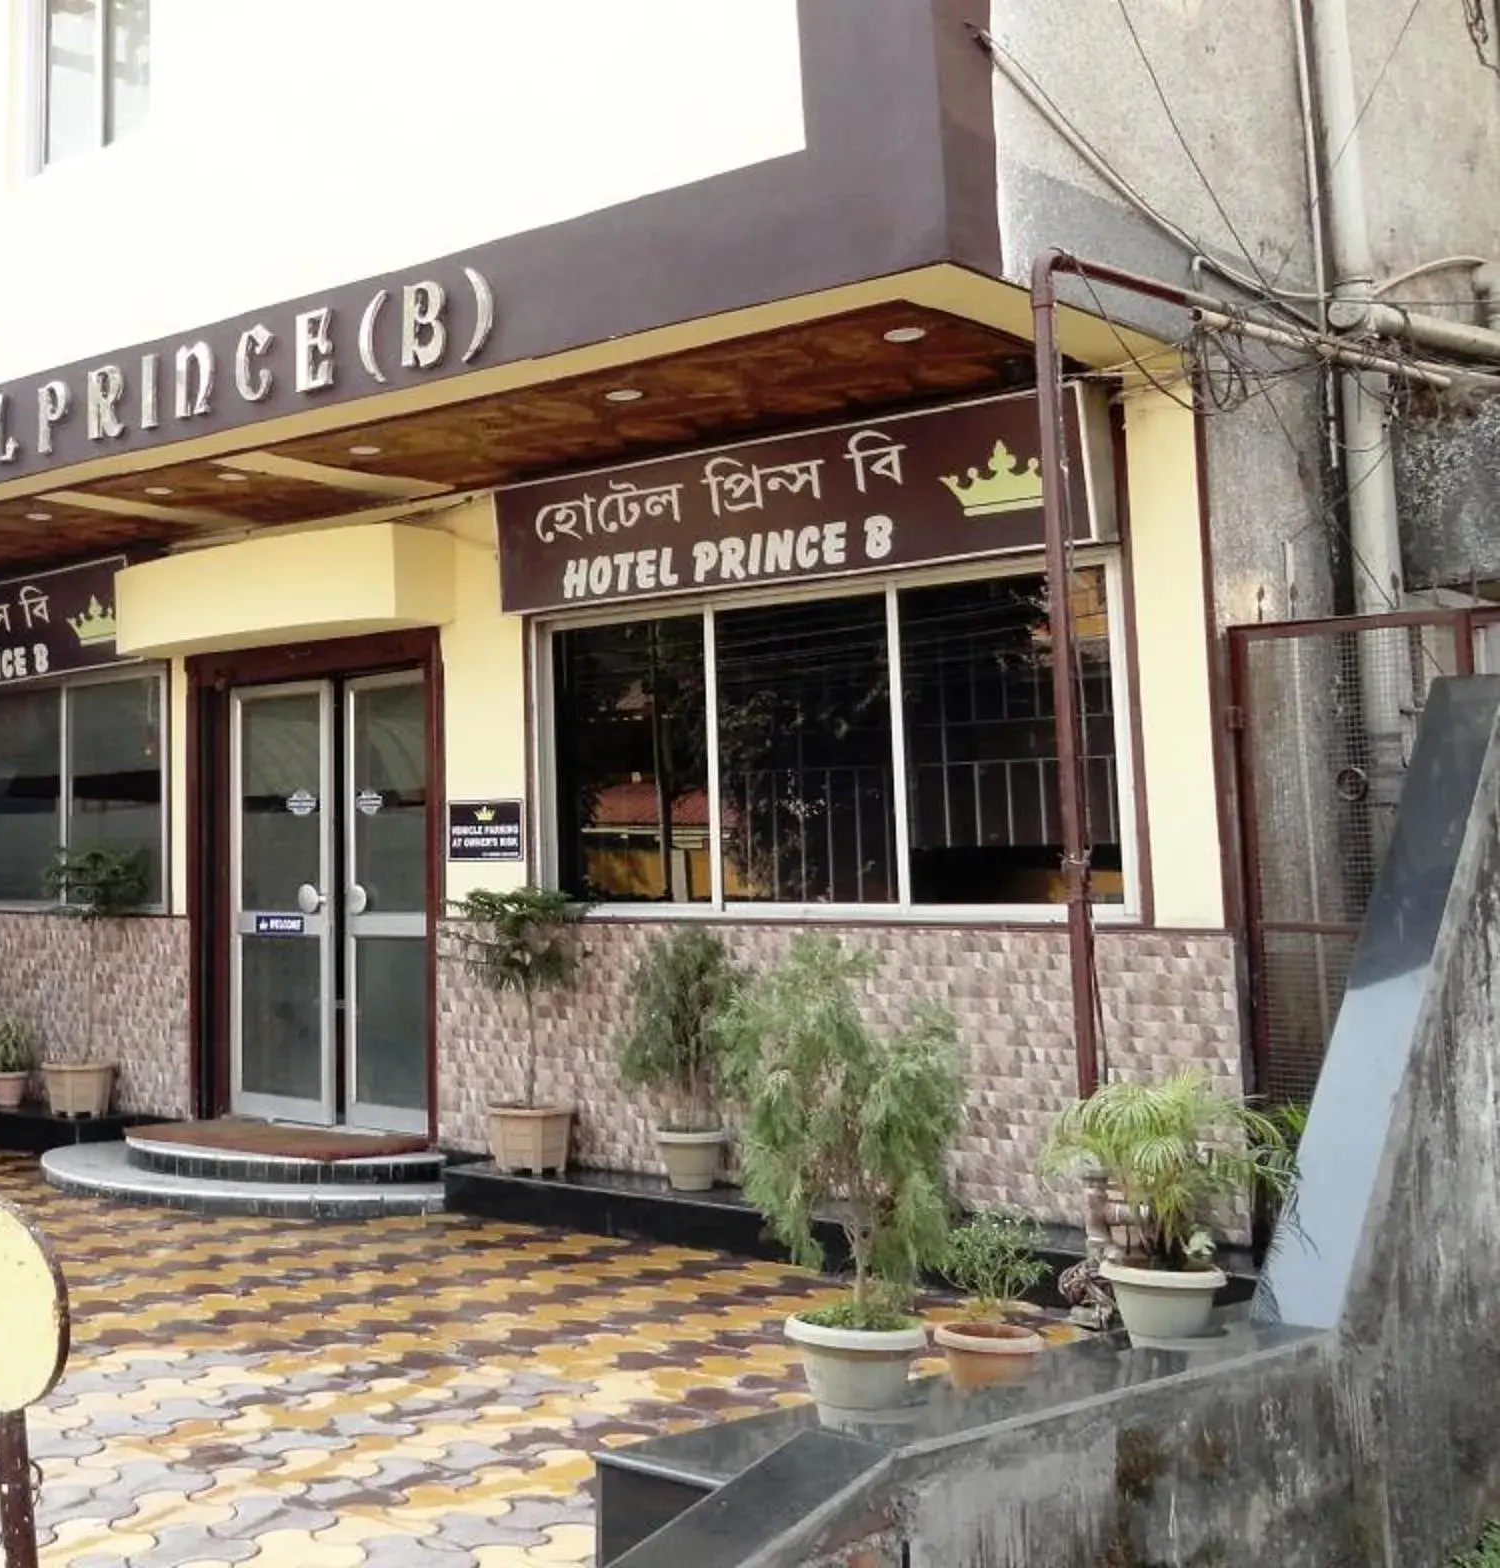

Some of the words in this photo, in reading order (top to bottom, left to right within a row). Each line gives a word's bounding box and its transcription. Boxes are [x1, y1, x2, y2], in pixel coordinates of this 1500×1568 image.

[37, 306, 334, 455] PRINCE
[358, 266, 494, 384] (B)
[534, 479, 685, 544] হোটেল
[701, 455, 827, 518] প্রিন্স
[843, 428, 908, 494] বি
[562, 547, 679, 600] HOTEL
[692, 520, 848, 584] PRINCE
[863, 514, 895, 561] B
[19, 585, 50, 629] বি
[33, 642, 50, 674] B
